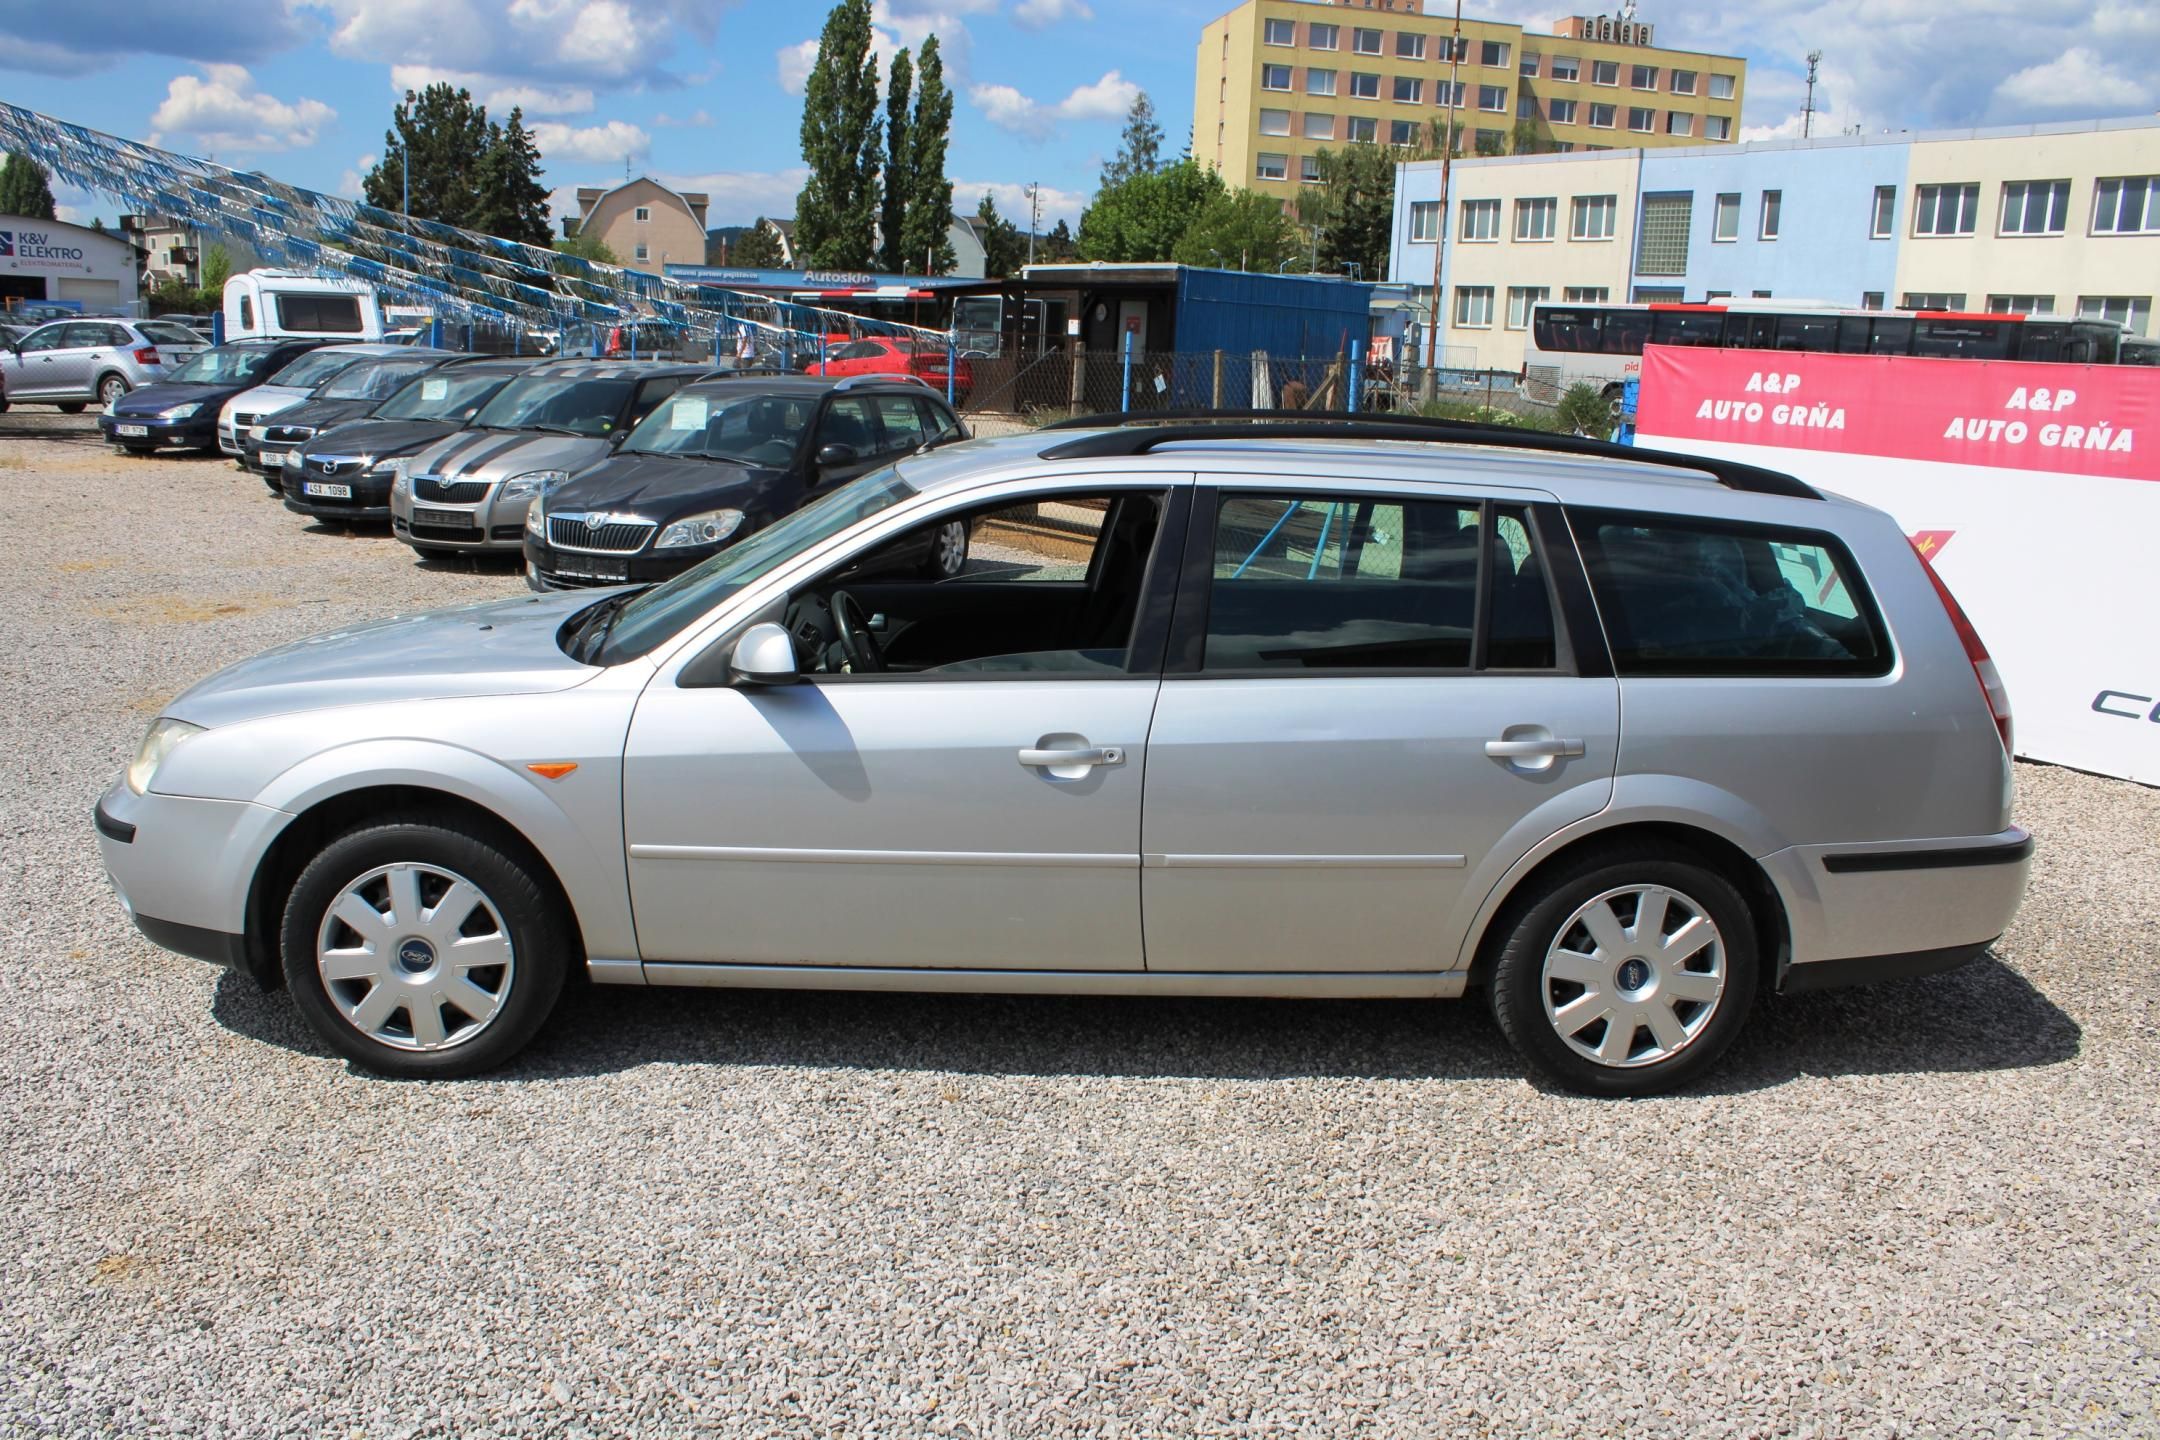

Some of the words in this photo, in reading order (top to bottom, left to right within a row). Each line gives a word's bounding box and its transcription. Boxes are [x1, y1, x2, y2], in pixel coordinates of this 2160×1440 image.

[19, 232, 48, 245] K&V
[20, 245, 83, 260] ELEKTRO
[803, 270, 871, 284] Autosklo
[1745, 372, 1801, 394] A&P
[2005, 387, 2077, 412] A&P
[1696, 399, 1764, 423] AUTO
[1771, 402, 1845, 429] GRŇA
[1943, 417, 2028, 444] AUTO
[2038, 420, 2134, 452] GRŇA
[328, 485, 347, 496] 1098
